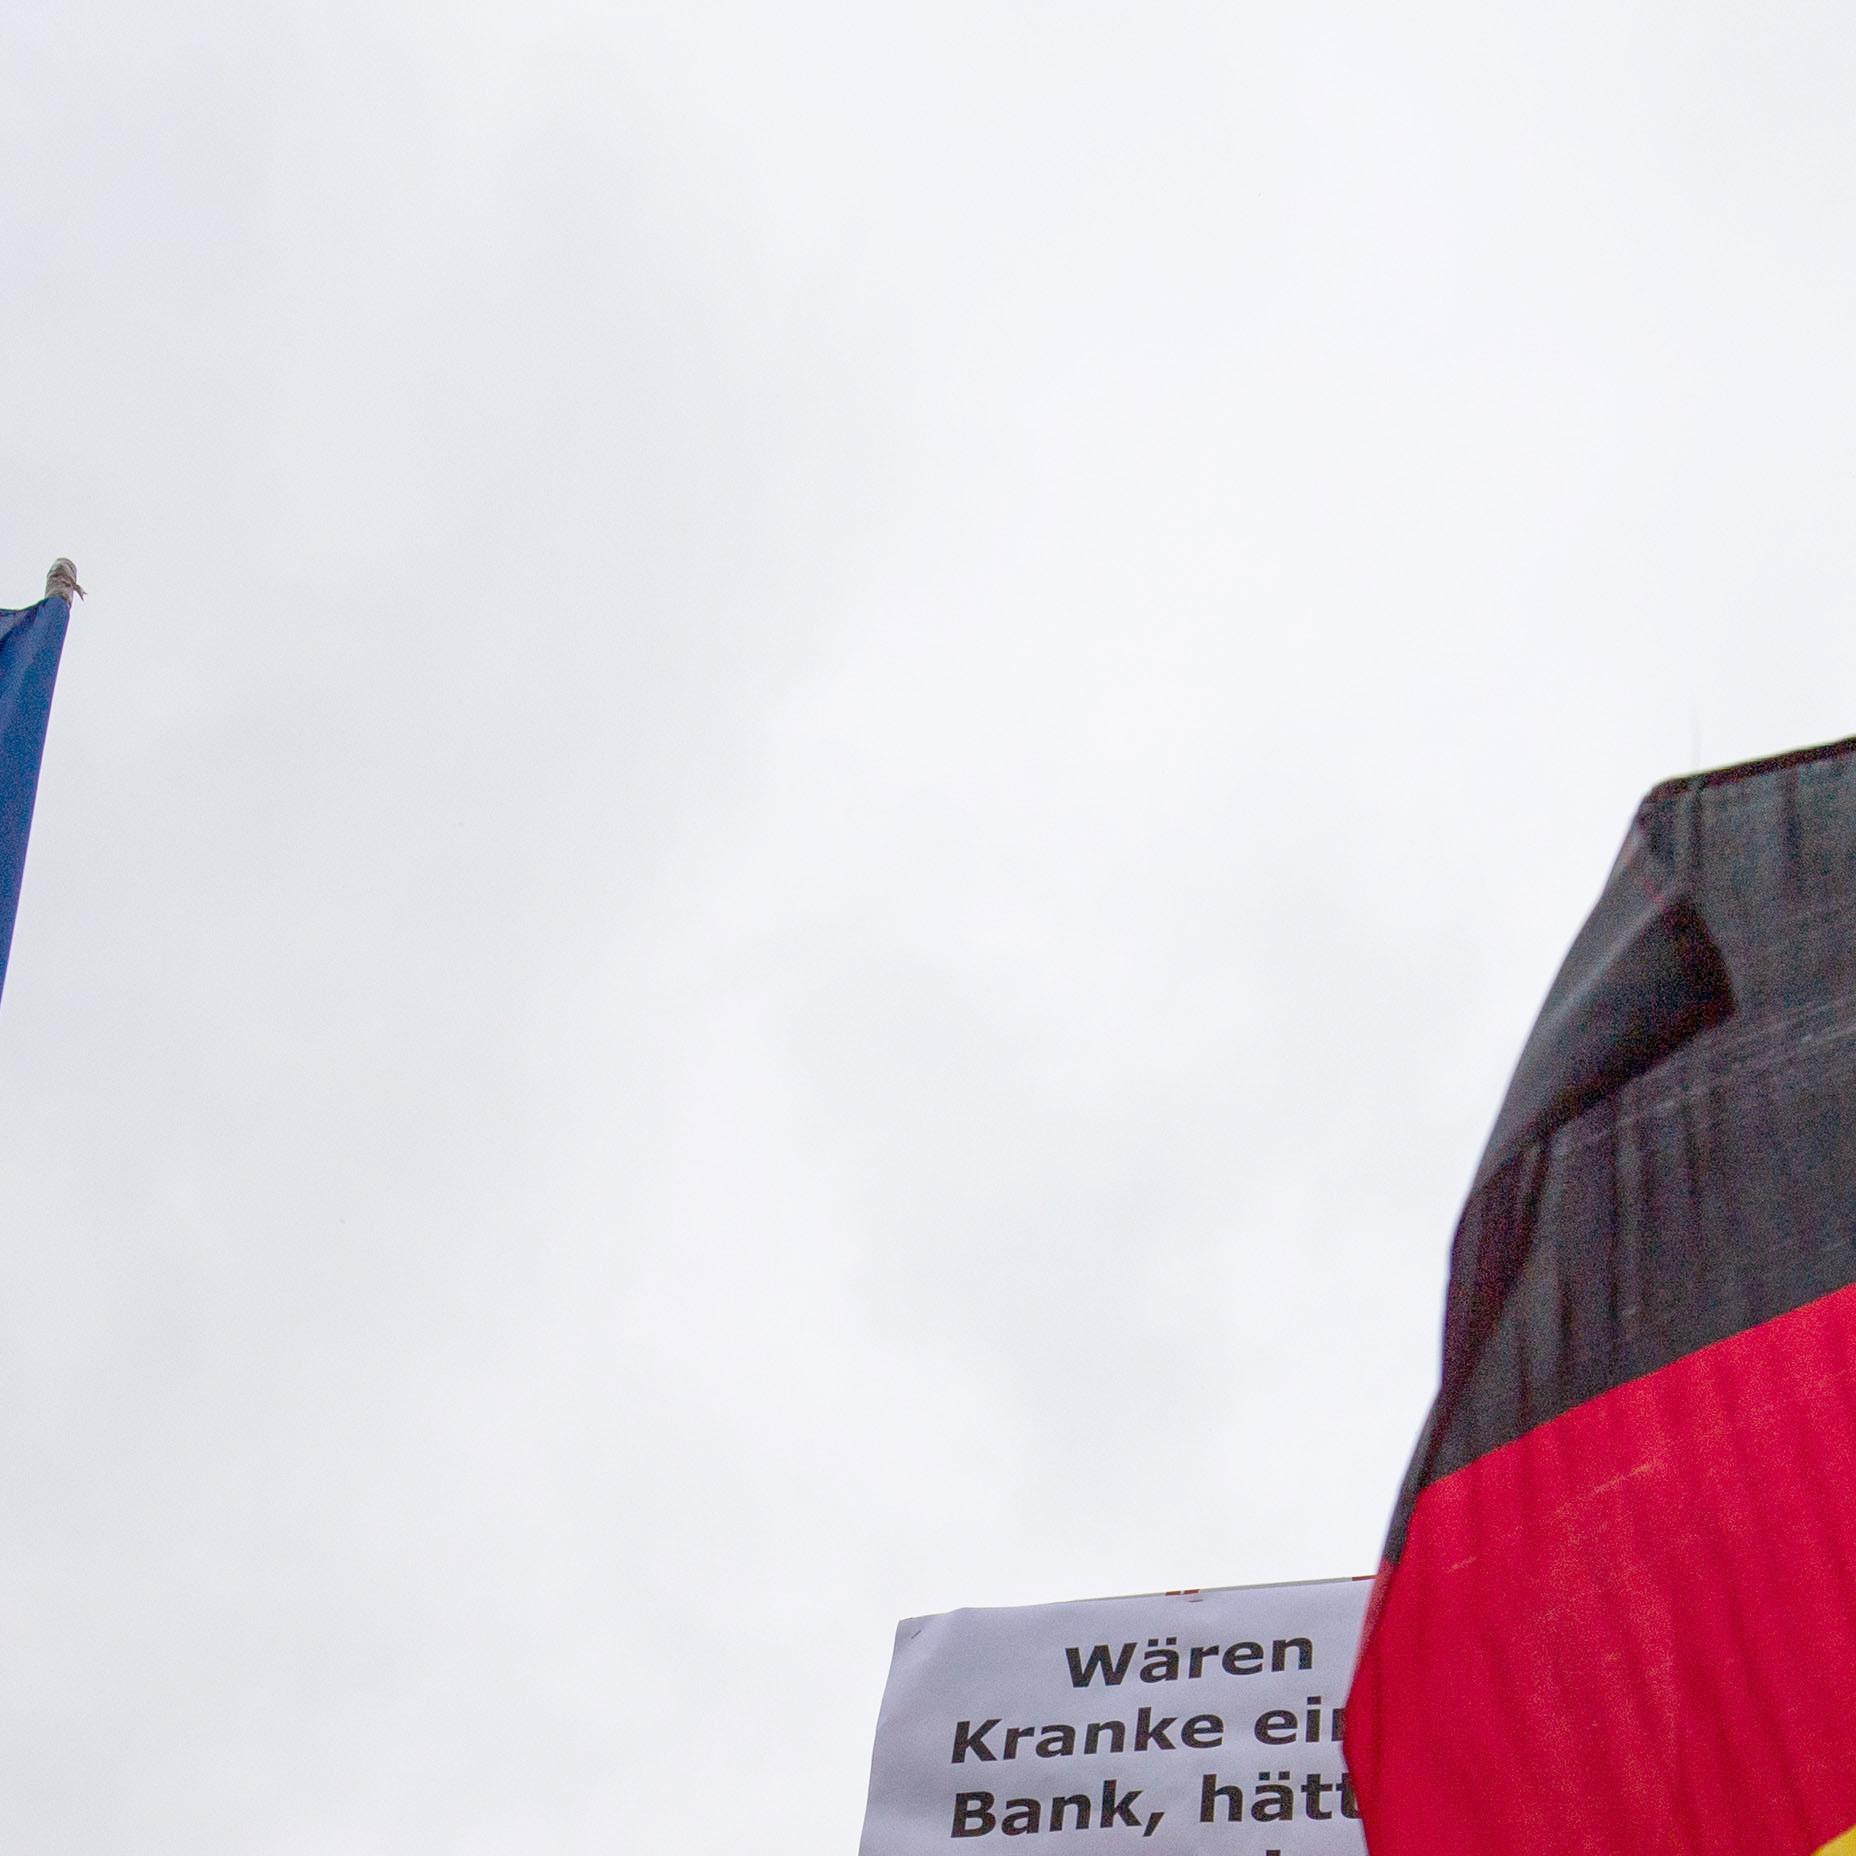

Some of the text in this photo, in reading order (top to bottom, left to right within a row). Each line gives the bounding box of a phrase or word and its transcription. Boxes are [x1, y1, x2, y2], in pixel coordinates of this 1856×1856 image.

[1066, 1637, 1312, 1687] Wären
[951, 1707, 1223, 1763] Kranke
[951, 1780, 1164, 1837] Bank,
